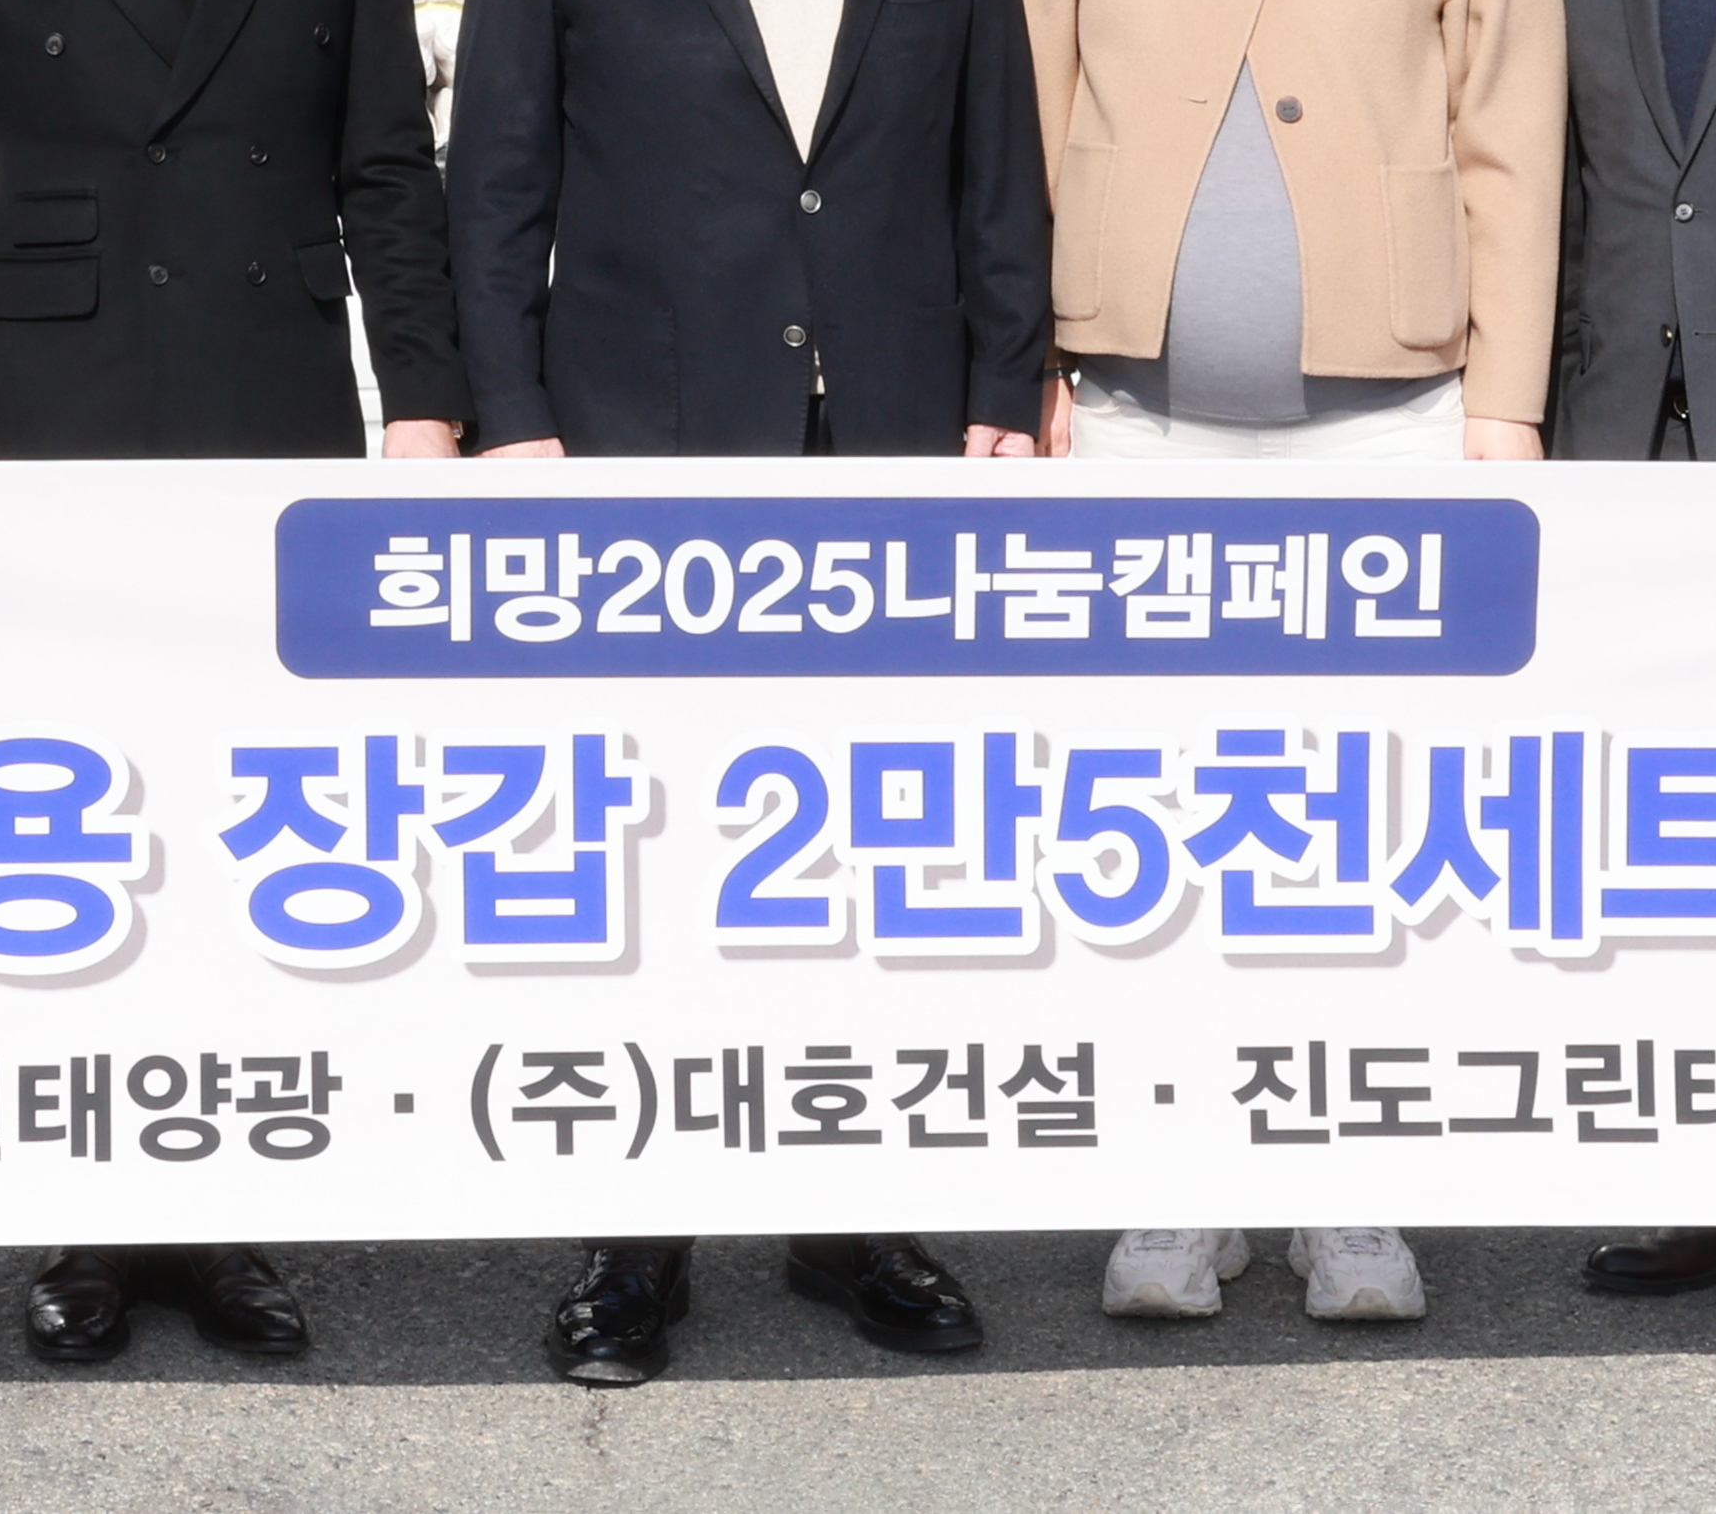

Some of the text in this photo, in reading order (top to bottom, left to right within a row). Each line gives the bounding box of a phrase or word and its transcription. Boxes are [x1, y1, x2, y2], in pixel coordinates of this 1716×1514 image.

[370, 533, 1442, 642] 희망2025나눔캠페인
[222, 735, 631, 949] 장갑
[471, 1042, 1098, 1161] (주)대호건설
